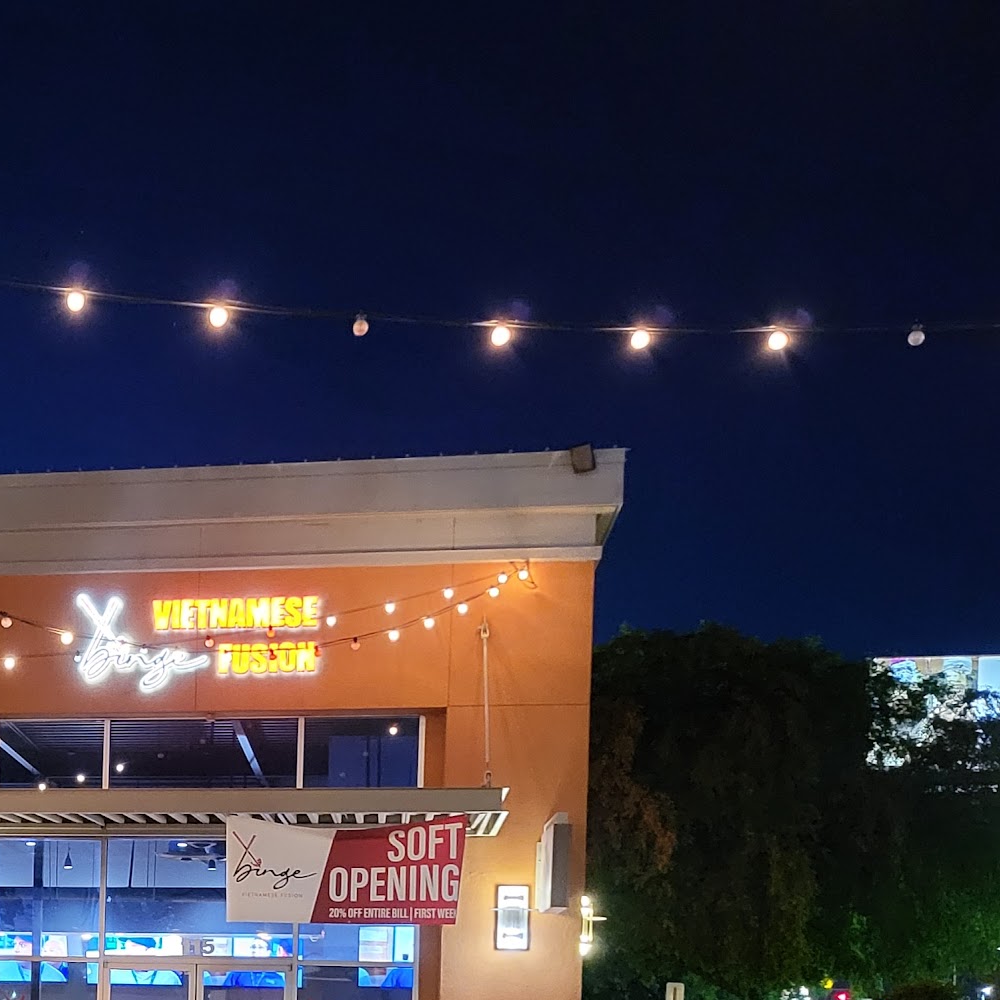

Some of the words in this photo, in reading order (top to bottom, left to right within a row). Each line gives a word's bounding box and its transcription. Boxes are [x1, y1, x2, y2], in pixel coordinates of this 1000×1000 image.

[152, 596, 319, 630] VIETNAMESE
[76, 593, 210, 693] binge
[217, 641, 317, 675] FUSION
[233, 831, 318, 890] binge
[387, 822, 464, 862] SOFT
[328, 863, 460, 903] OPENING
[328, 907, 347, 919] 20%
[347, 907, 363, 919] OFF
[363, 907, 391, 919] ENTIRE
[391, 907, 409, 919] BILL
[413, 908, 436, 919] FIRST
